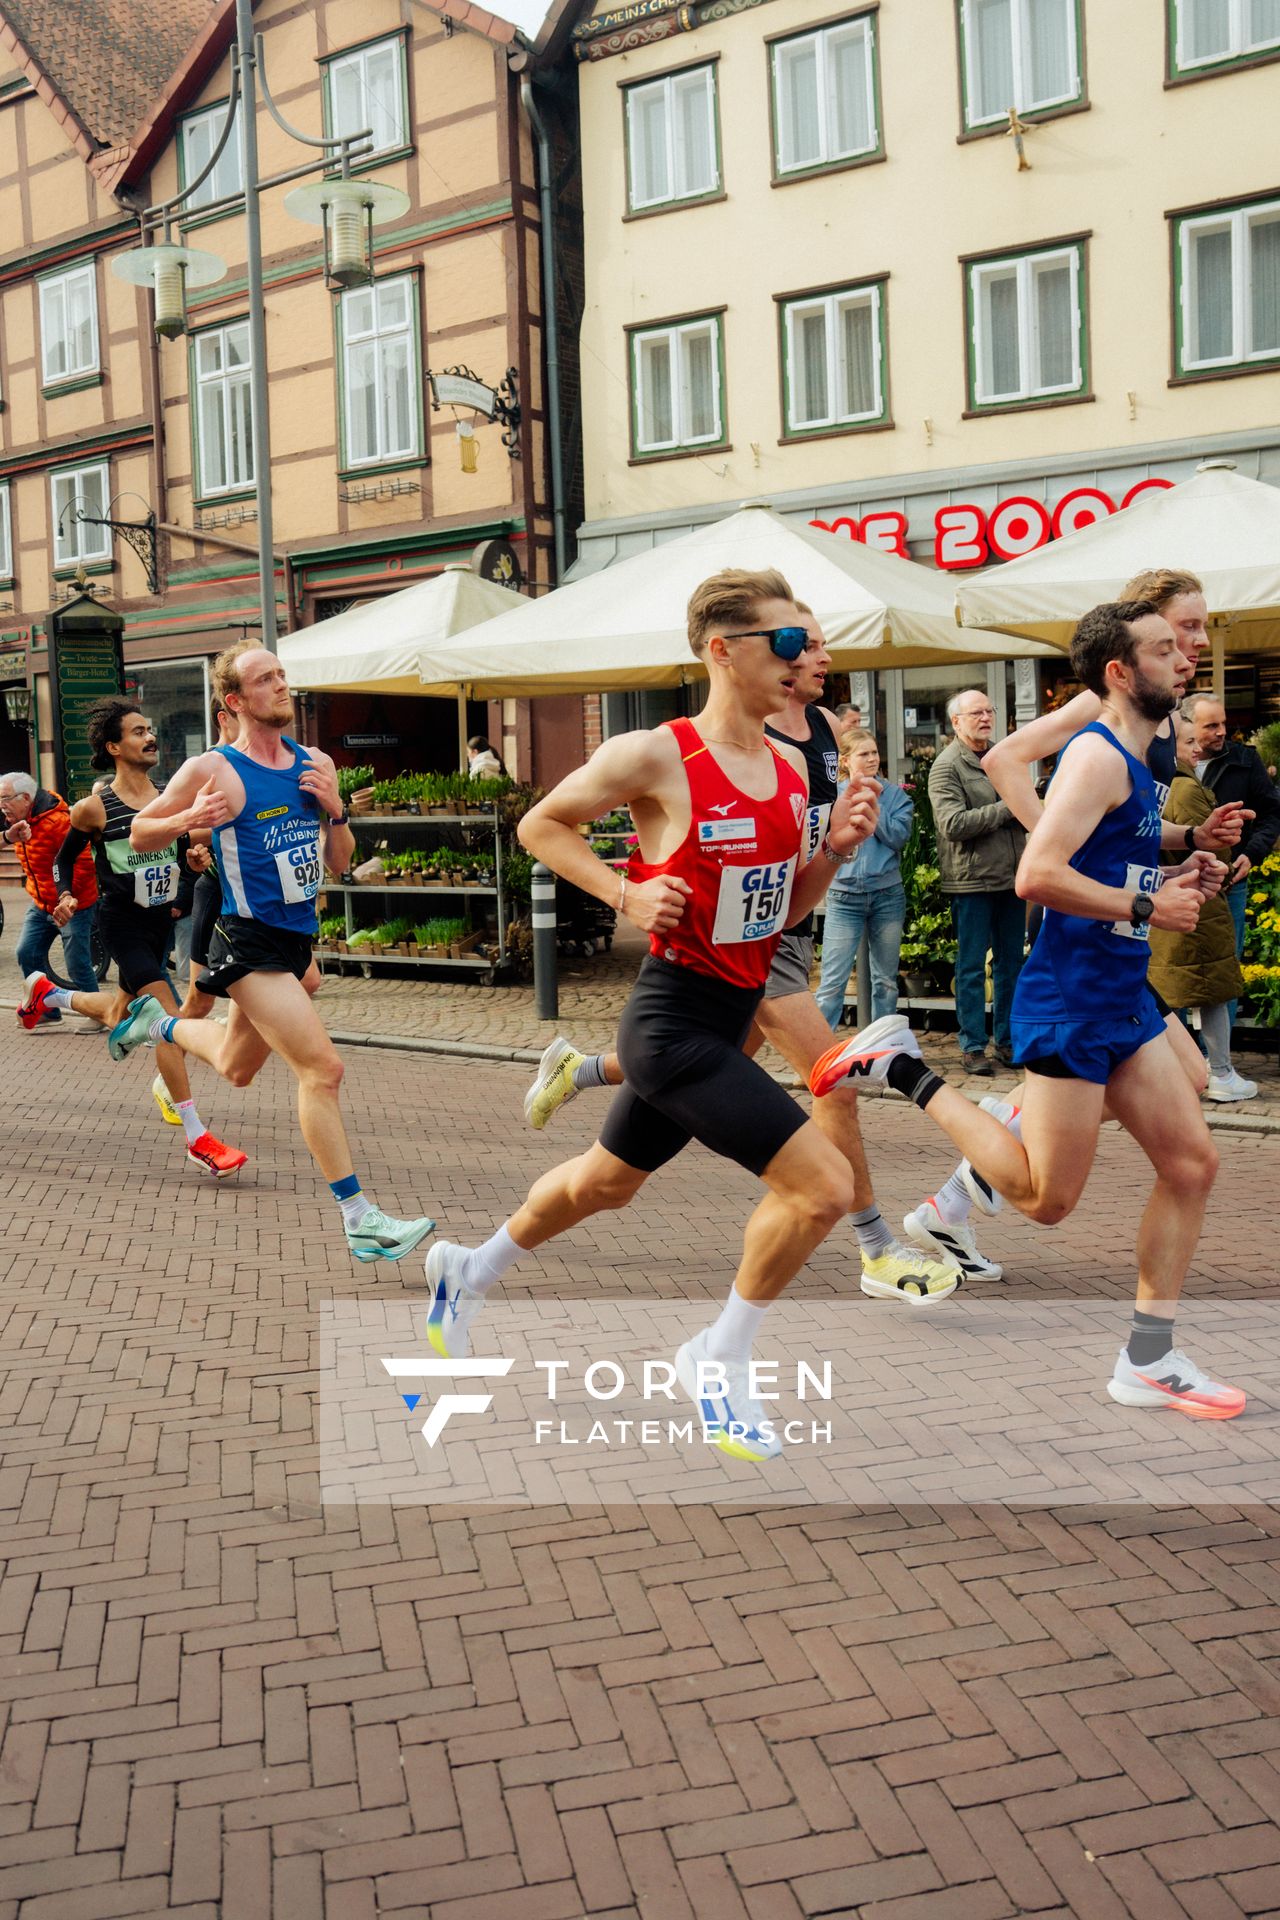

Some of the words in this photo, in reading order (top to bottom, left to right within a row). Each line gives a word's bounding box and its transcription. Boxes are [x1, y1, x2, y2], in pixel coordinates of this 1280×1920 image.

[281, 818, 300, 832] LAV
[127, 850, 164, 867] RUNNERS
[287, 843, 318, 867] GLS
[144, 864, 172, 882] GLS
[294, 861, 320, 887] 928
[742, 862, 788, 893] GLS
[1138, 868, 1163, 894] GL
[145, 878, 171, 898] 142
[742, 887, 785, 923] 150
